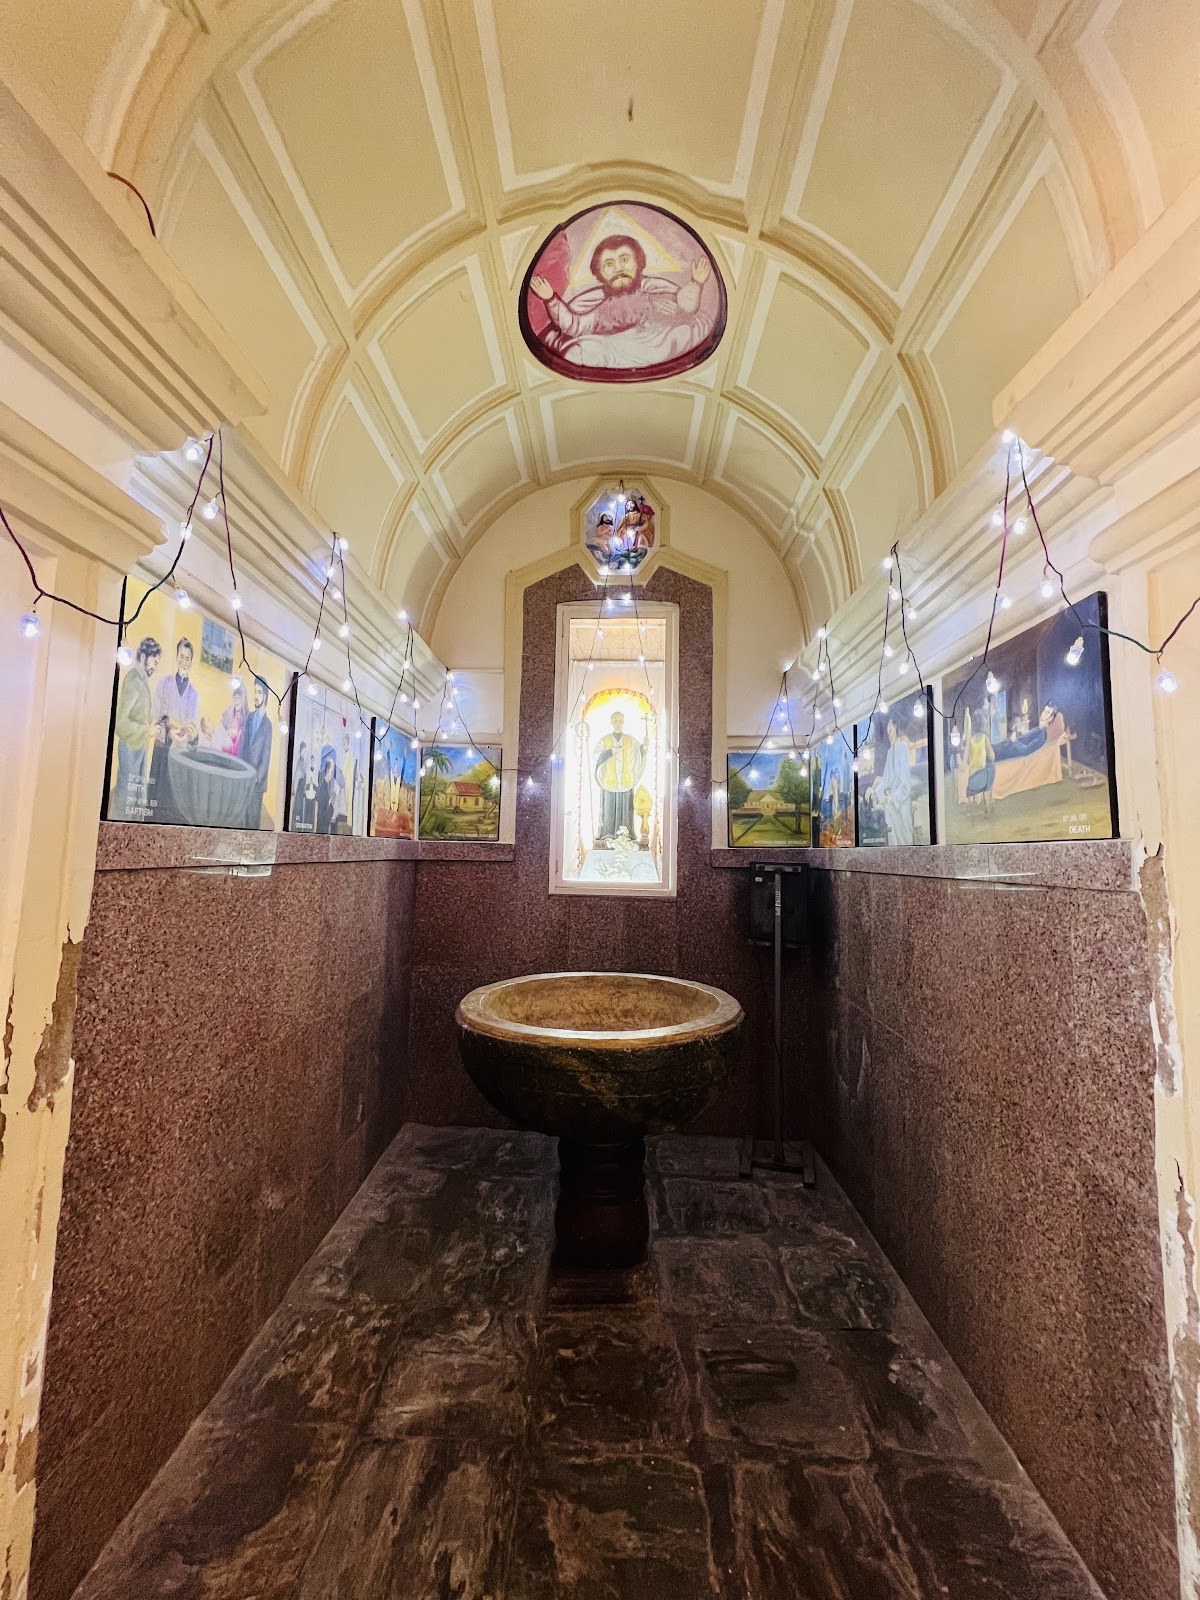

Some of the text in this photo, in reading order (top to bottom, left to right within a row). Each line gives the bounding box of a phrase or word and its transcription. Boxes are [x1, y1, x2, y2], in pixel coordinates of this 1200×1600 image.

[127, 782, 146, 793] BIRTH
[125, 806, 154, 817] BAPTISM
[1068, 824, 1091, 834] DEATH
